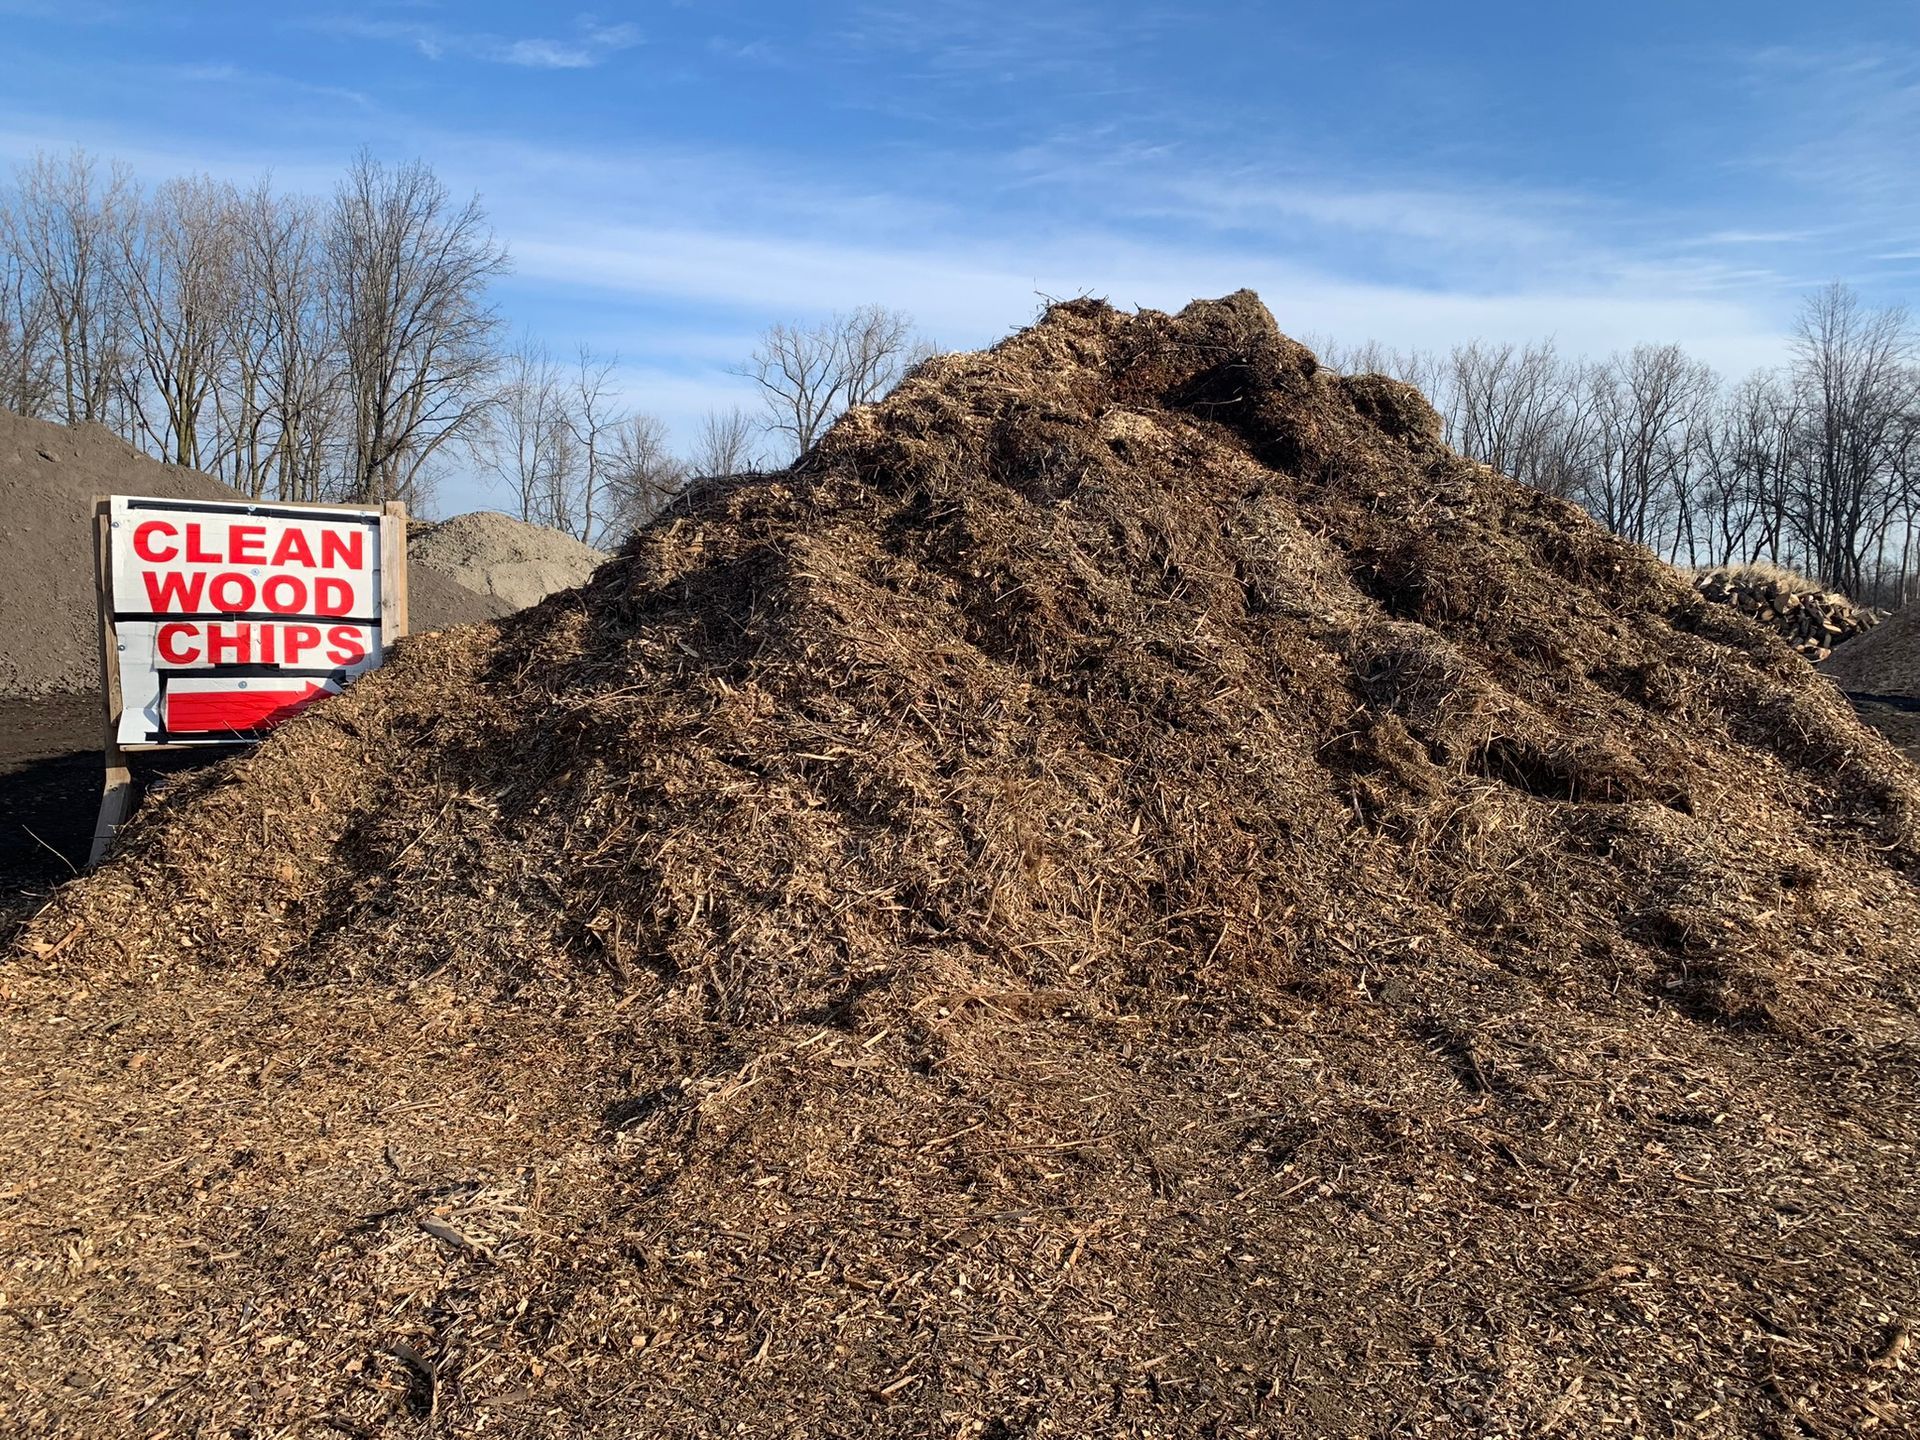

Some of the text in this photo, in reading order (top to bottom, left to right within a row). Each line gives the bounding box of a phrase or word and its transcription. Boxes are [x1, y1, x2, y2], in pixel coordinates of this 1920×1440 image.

[132, 520, 364, 571] CLEAN
[141, 571, 356, 617] WOOD
[156, 622, 366, 666] CHIPS
